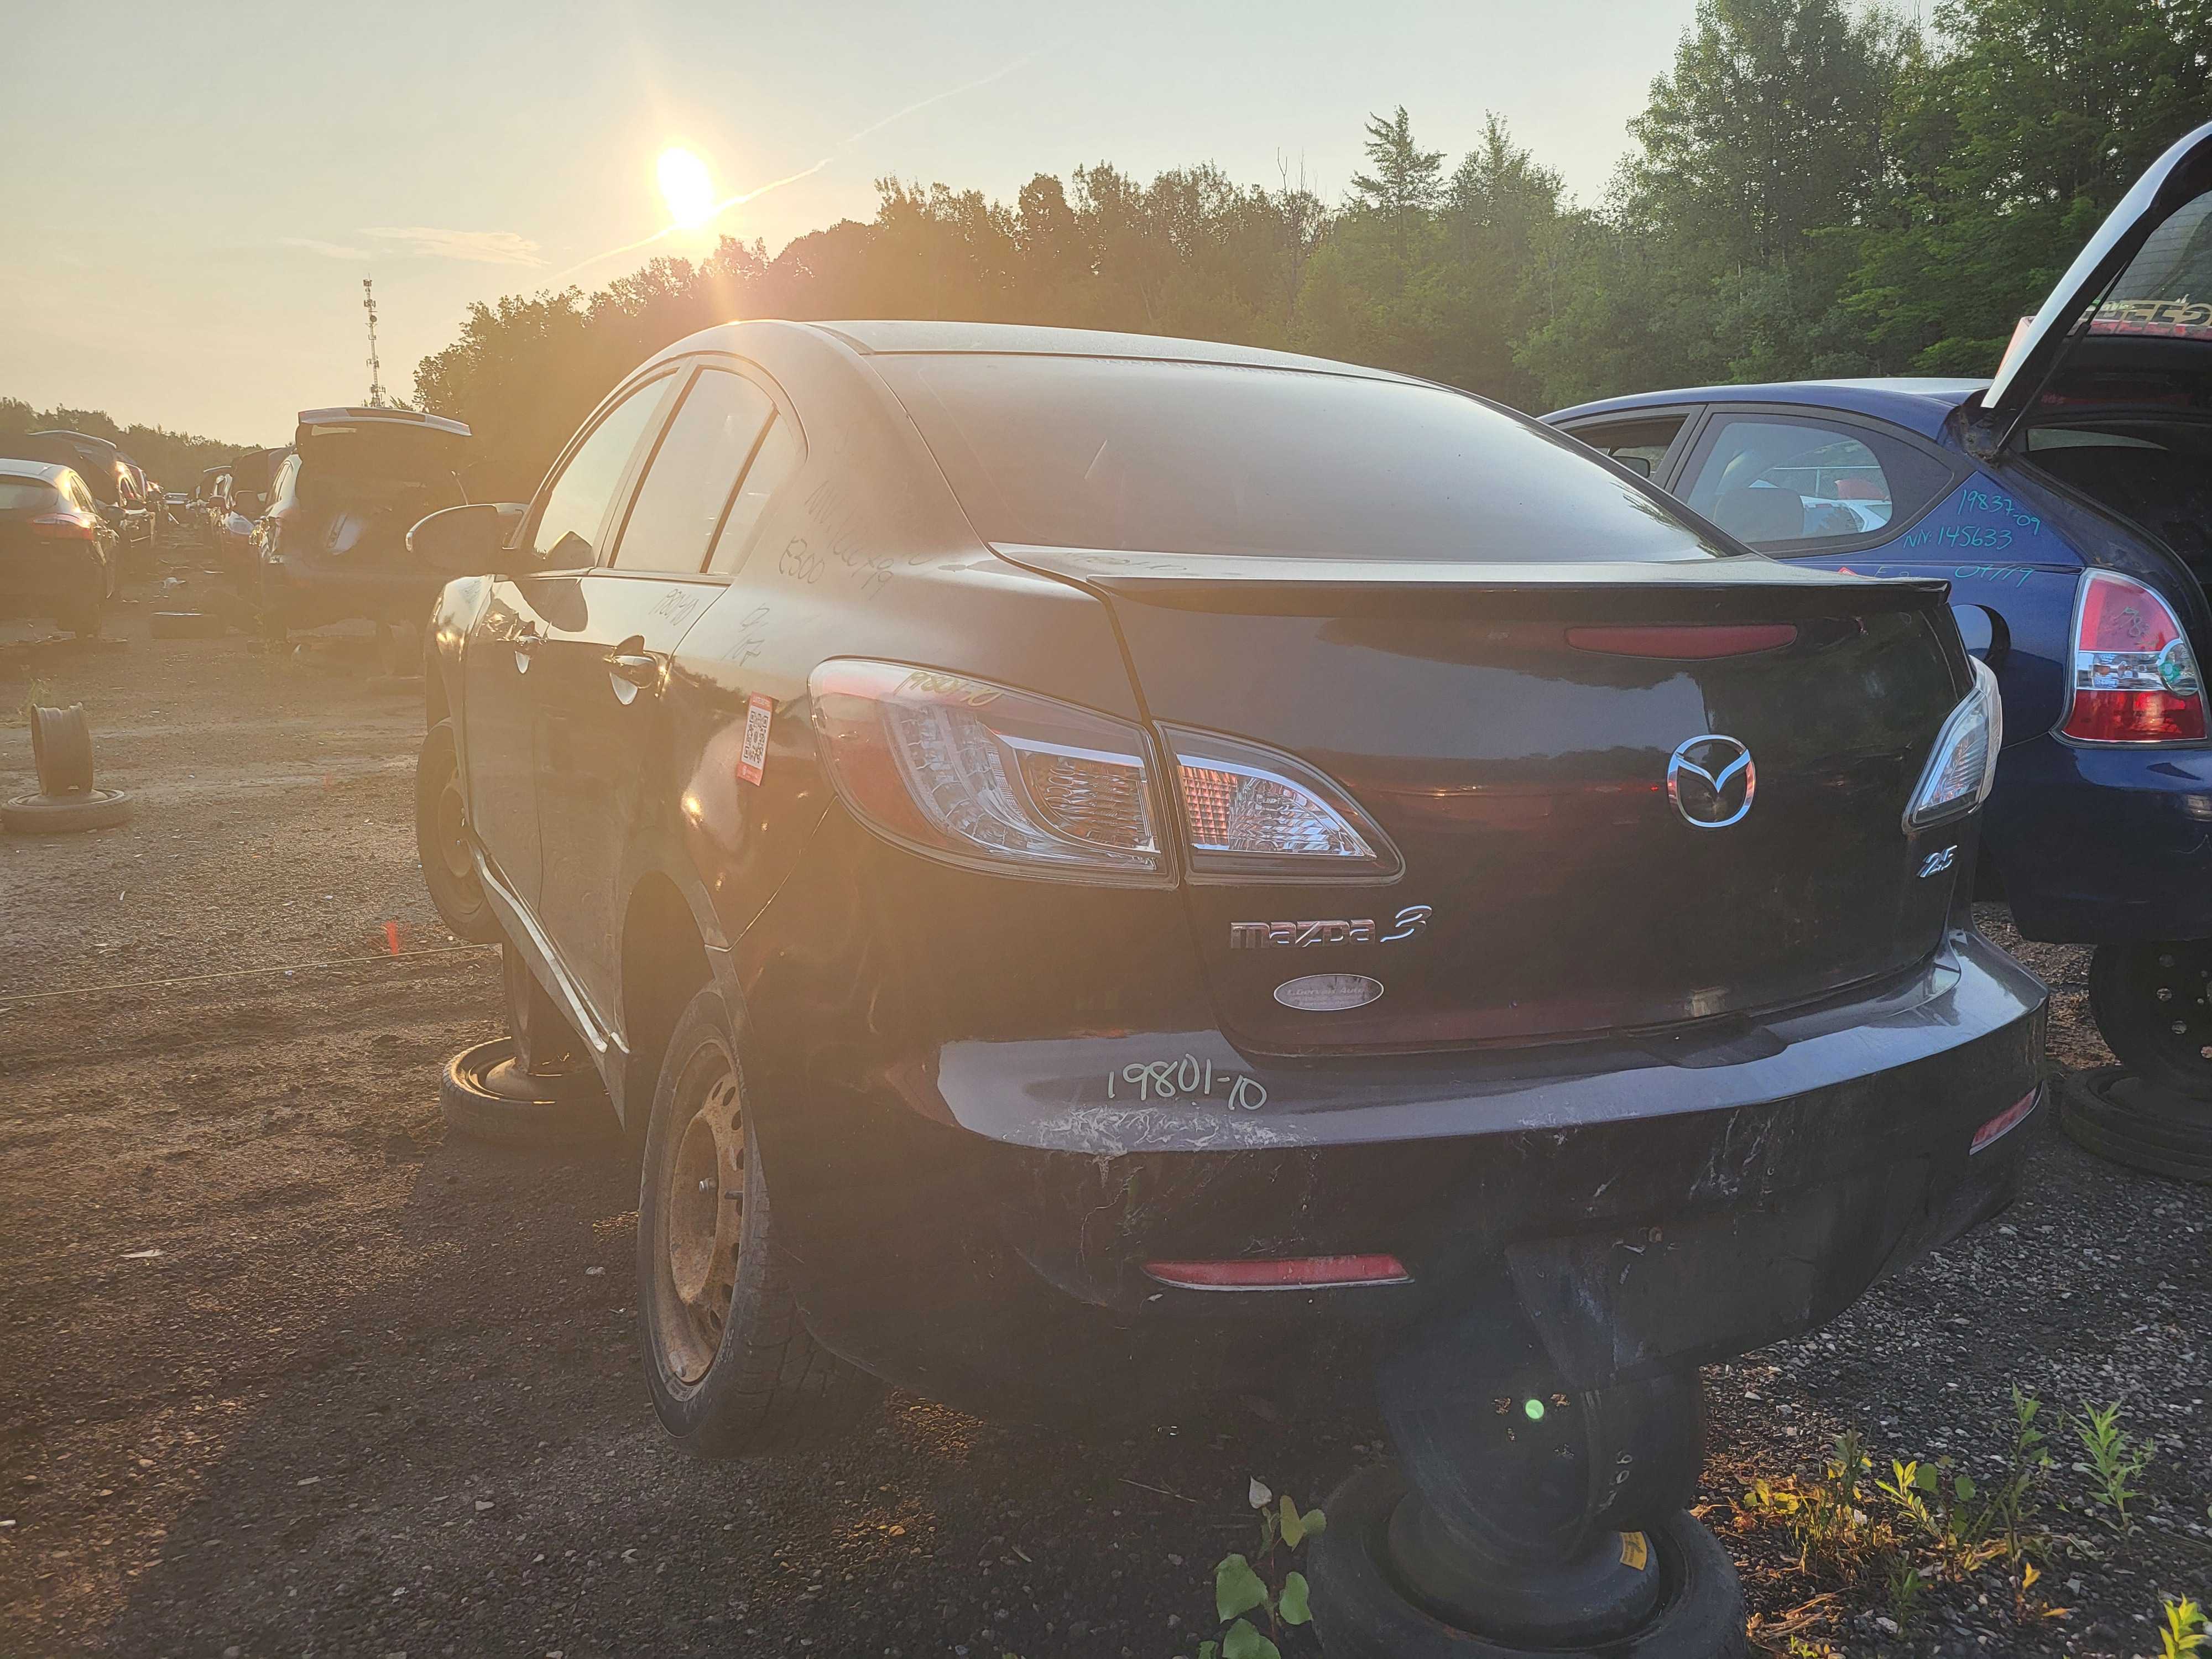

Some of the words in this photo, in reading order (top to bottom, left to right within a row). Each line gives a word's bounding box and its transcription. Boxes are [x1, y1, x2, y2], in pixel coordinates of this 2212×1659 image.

[1958, 489, 2041, 535] 19837-09
[1937, 525, 2012, 550] 145633
[1380, 905, 1433, 943] 3
[1108, 1053, 1267, 1110] 19801-10
